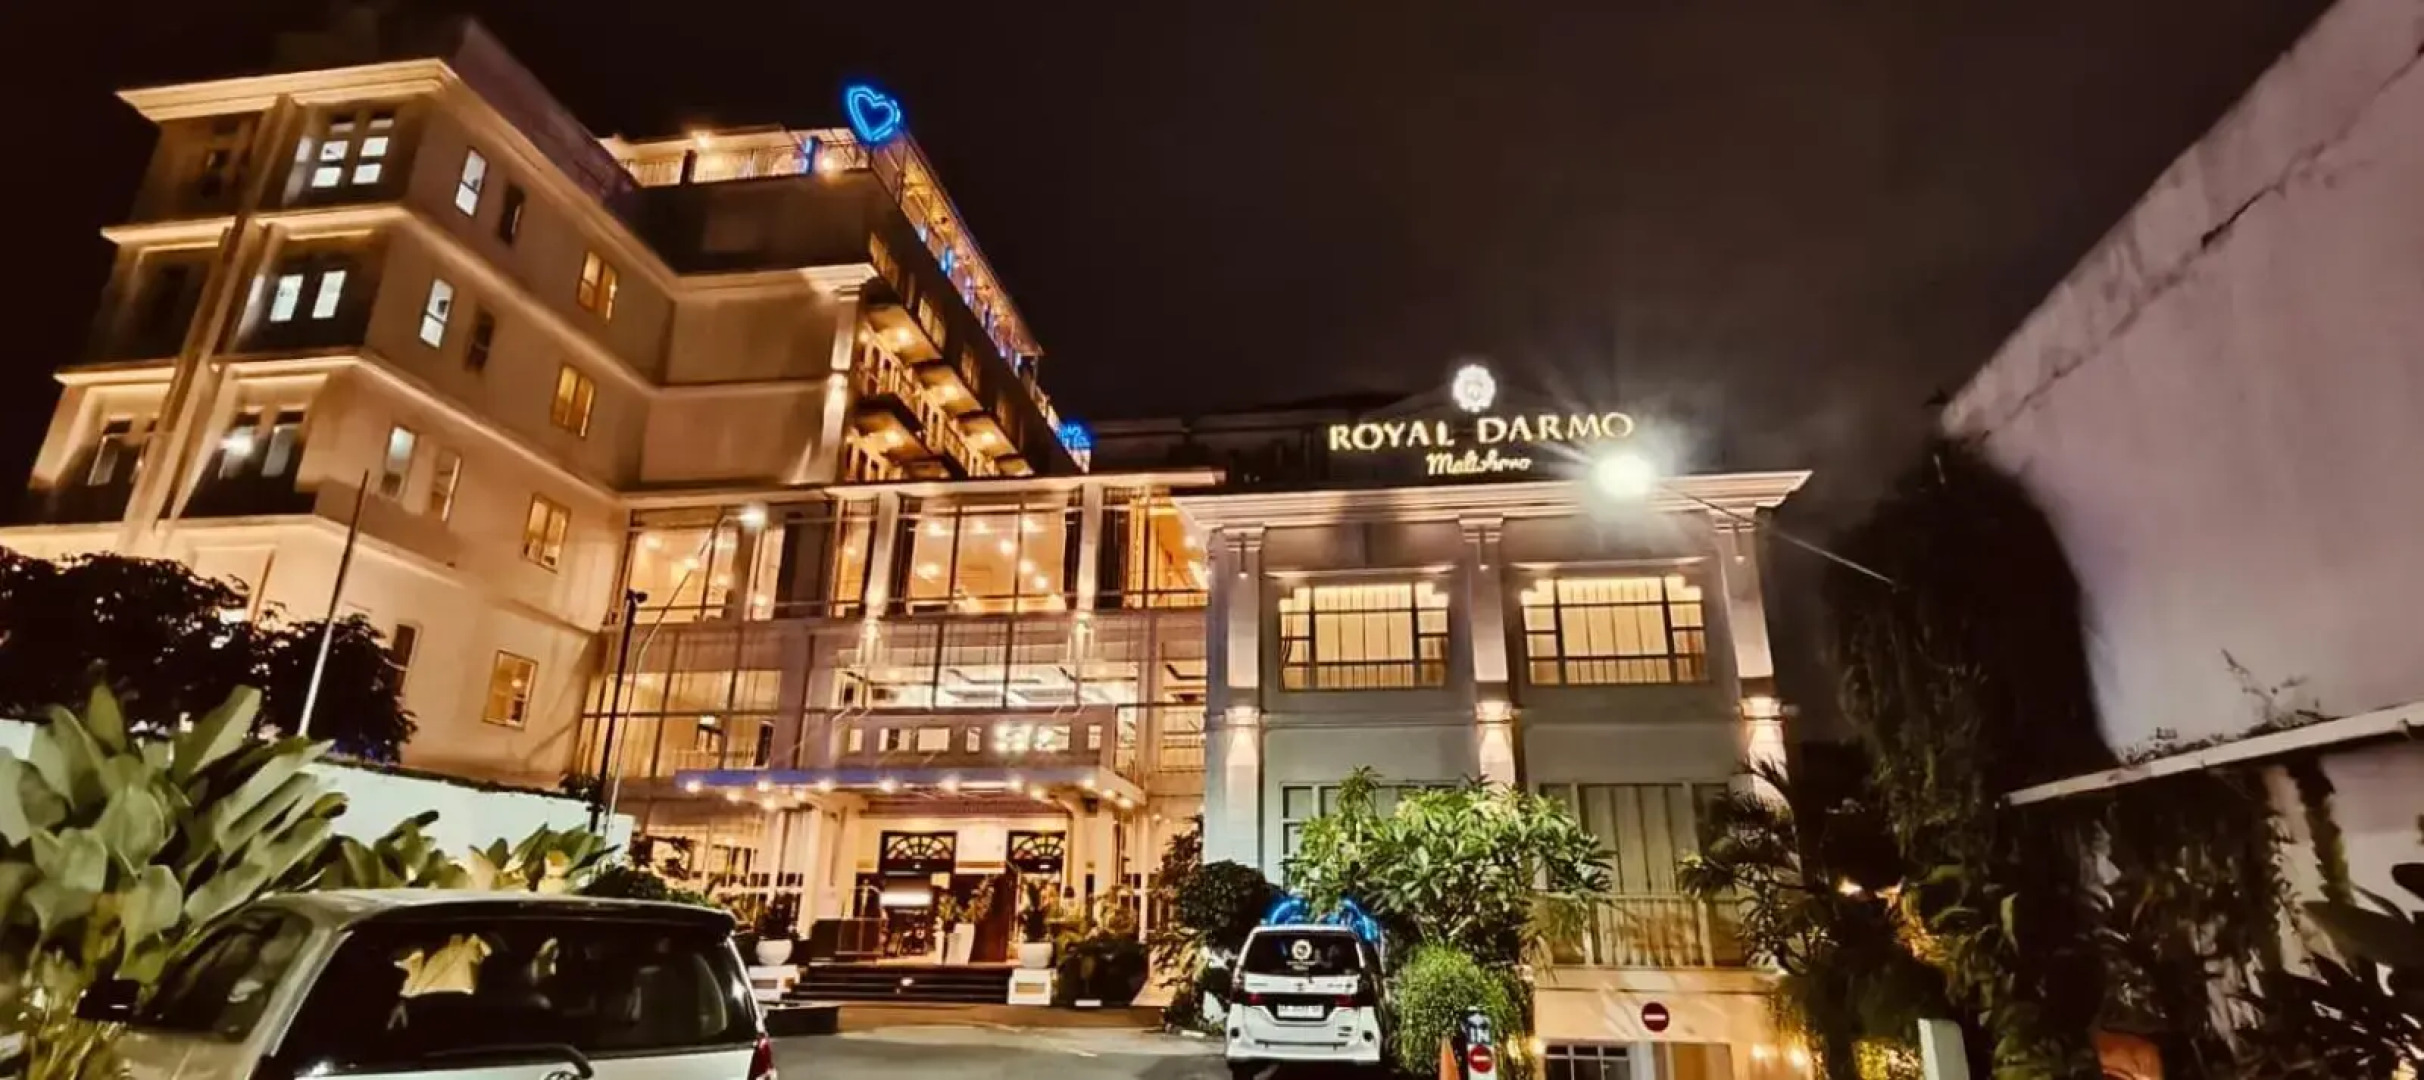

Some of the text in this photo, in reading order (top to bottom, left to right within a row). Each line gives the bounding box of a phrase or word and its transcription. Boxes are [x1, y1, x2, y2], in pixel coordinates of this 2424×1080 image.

[1329, 412, 1634, 451] ROYAL DARMO
[1470, 1026, 1490, 1043] IN
